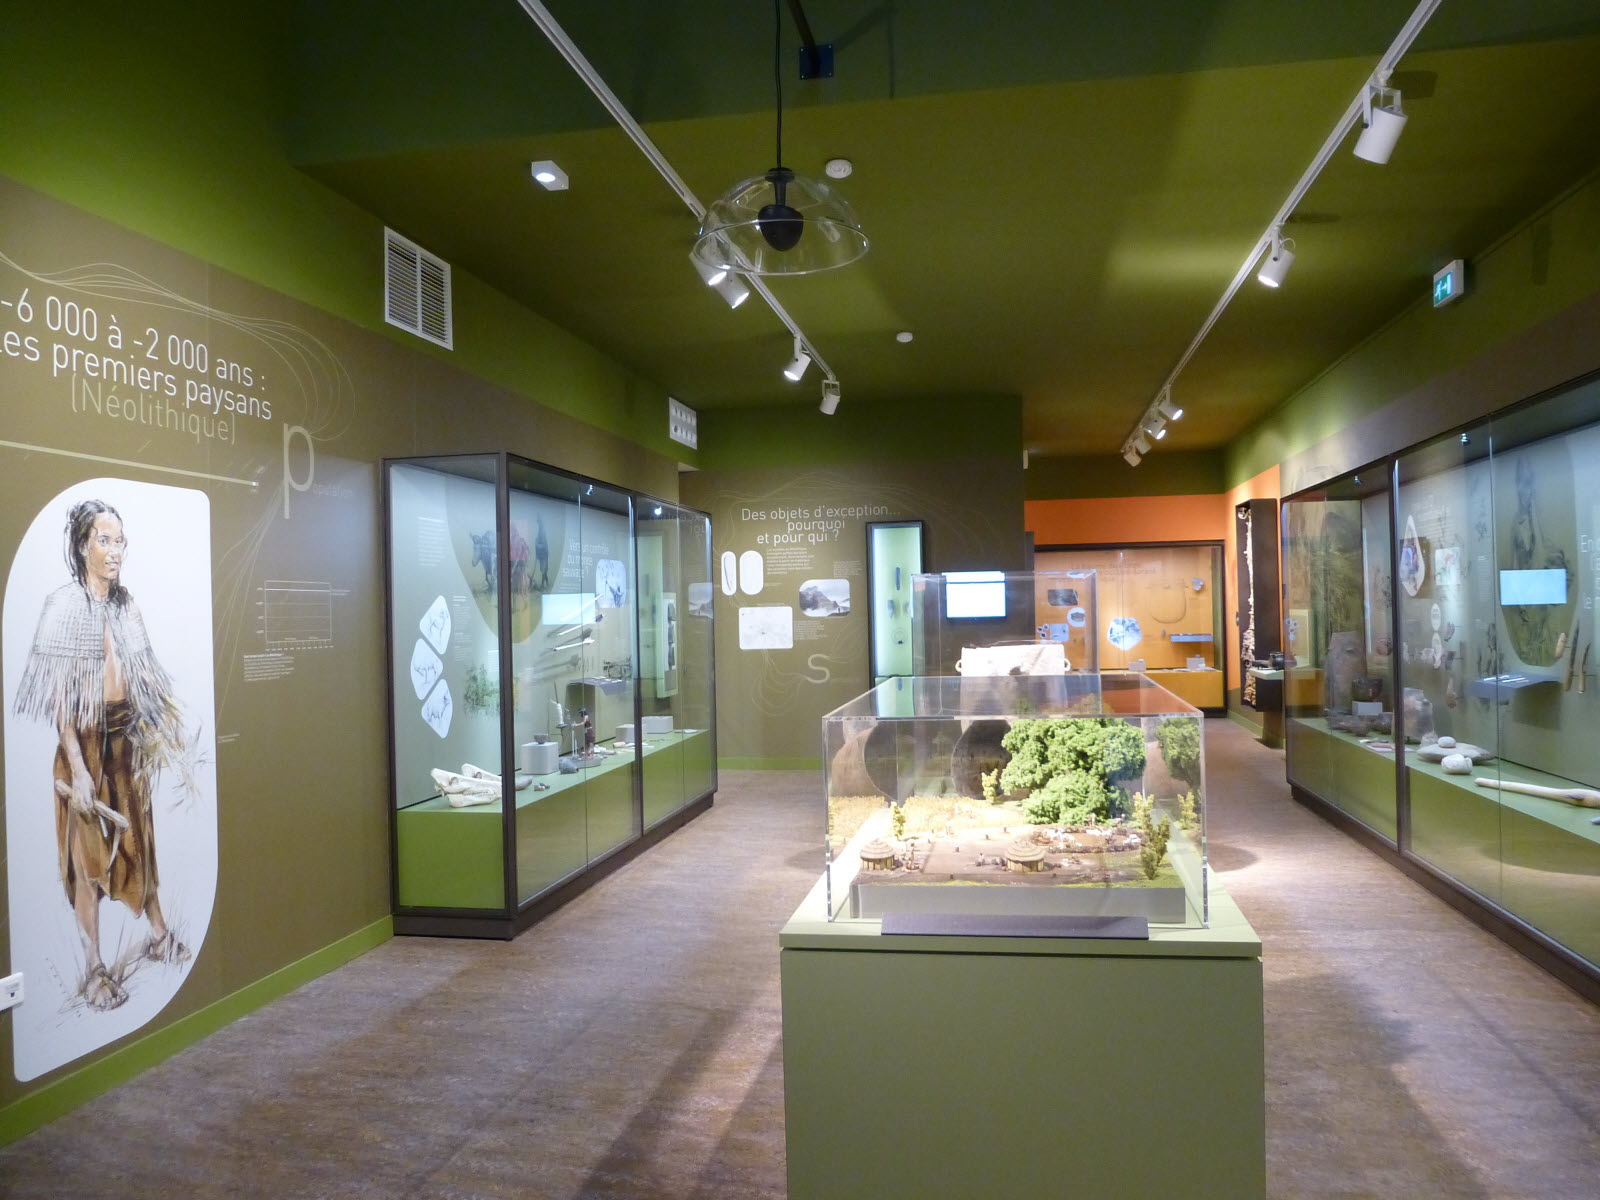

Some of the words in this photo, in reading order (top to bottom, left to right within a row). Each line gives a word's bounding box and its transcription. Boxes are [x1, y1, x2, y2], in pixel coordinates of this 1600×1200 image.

[0, 288, 33, 323] -6
[46, 296, 98, 342] 000
[108, 313, 122, 350] à
[133, 327, 159, 360] -2
[168, 334, 208, 374] 000
[216, 358, 254, 387] ans
[0, 331, 40, 361] es
[53, 343, 177, 396] premiers
[186, 379, 271, 420] paysans
[741, 508, 766, 521] Des
[770, 507, 810, 523] objets
[788, 517, 845, 534] pourquoi
[757, 533, 769, 544] et
[773, 531, 804, 547] pour
[807, 529, 828, 546] qui
